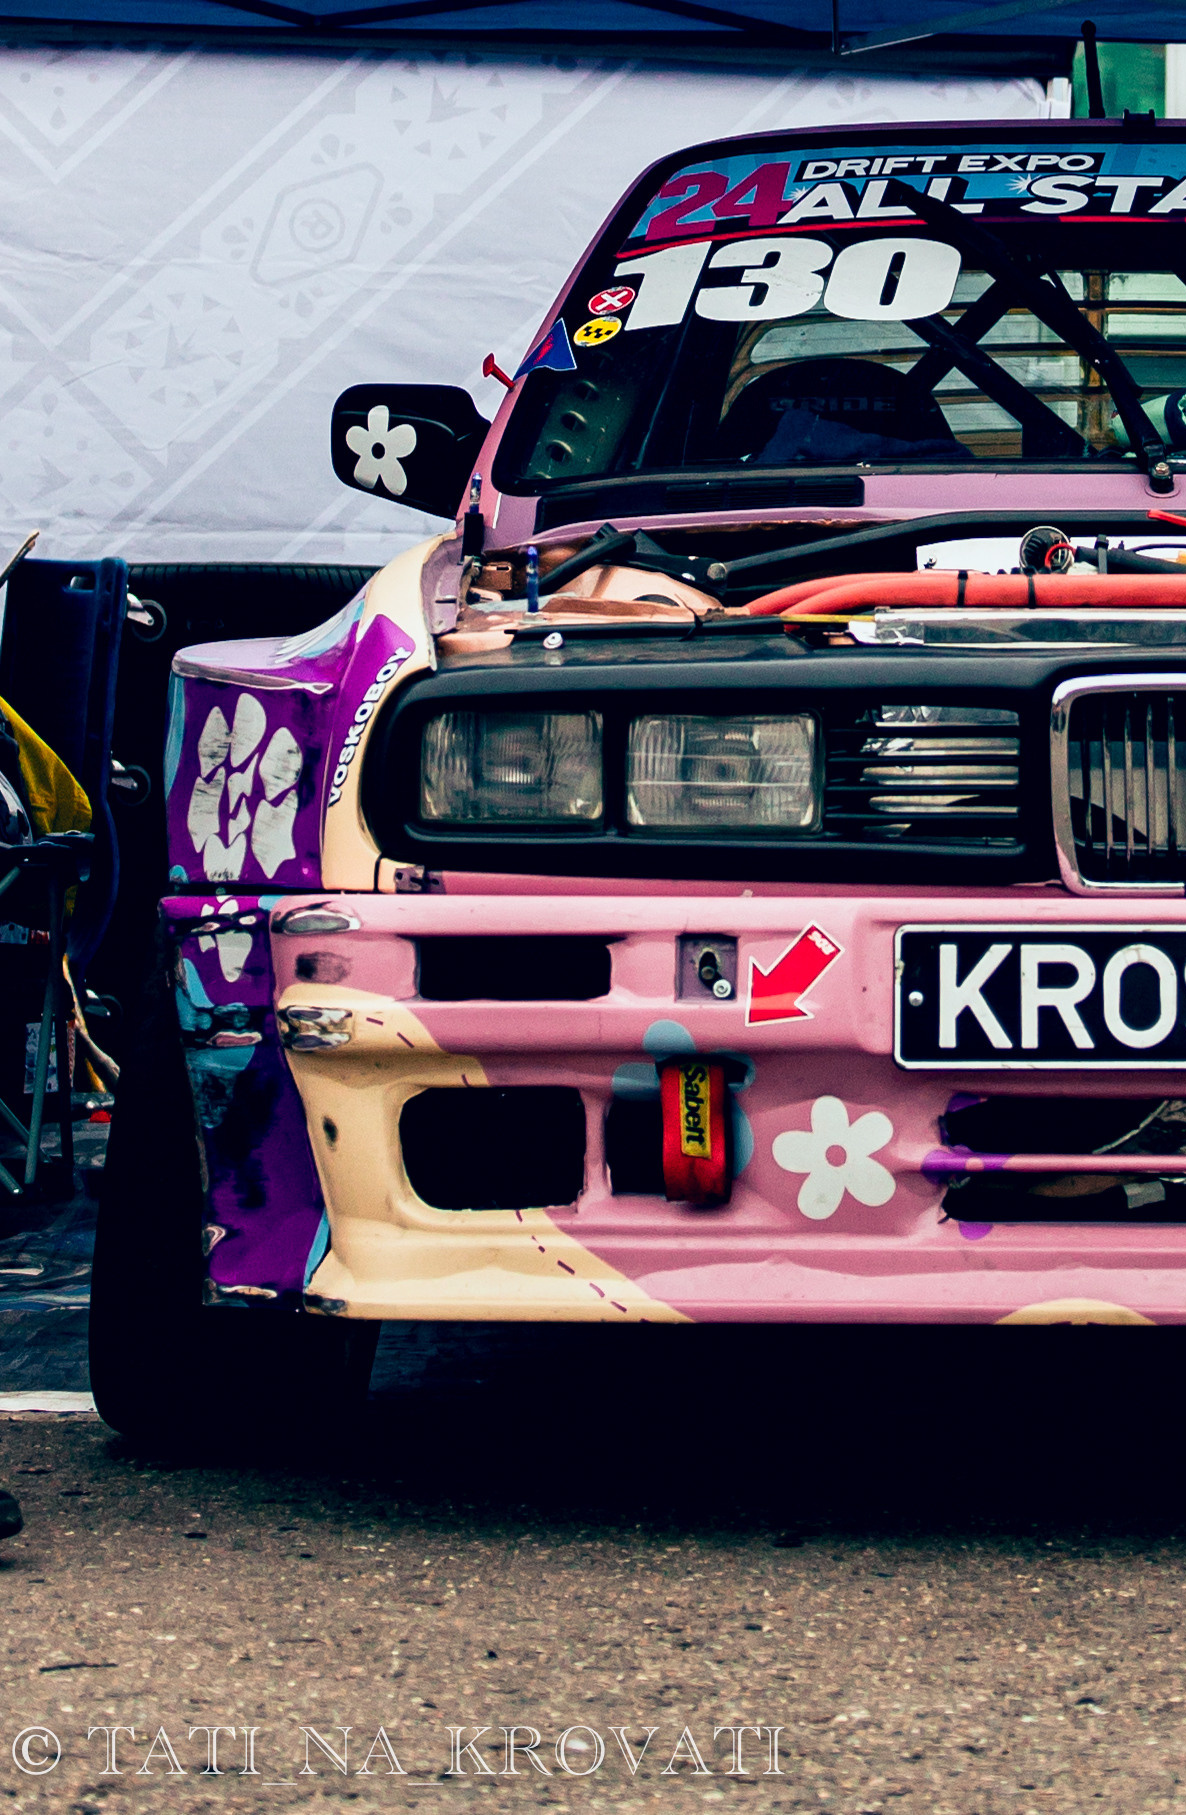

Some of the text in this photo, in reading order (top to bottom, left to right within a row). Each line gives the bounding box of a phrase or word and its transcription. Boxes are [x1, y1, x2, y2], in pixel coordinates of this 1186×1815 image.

[645, 160, 797, 241] 24
[778, 178, 984, 225] ALL
[802, 153, 1095, 181] DRIFT EXPO
[614, 237, 962, 332] 130
[328, 646, 411, 807] VOSKOBOY
[684, 1064, 707, 1146] Sabelt
